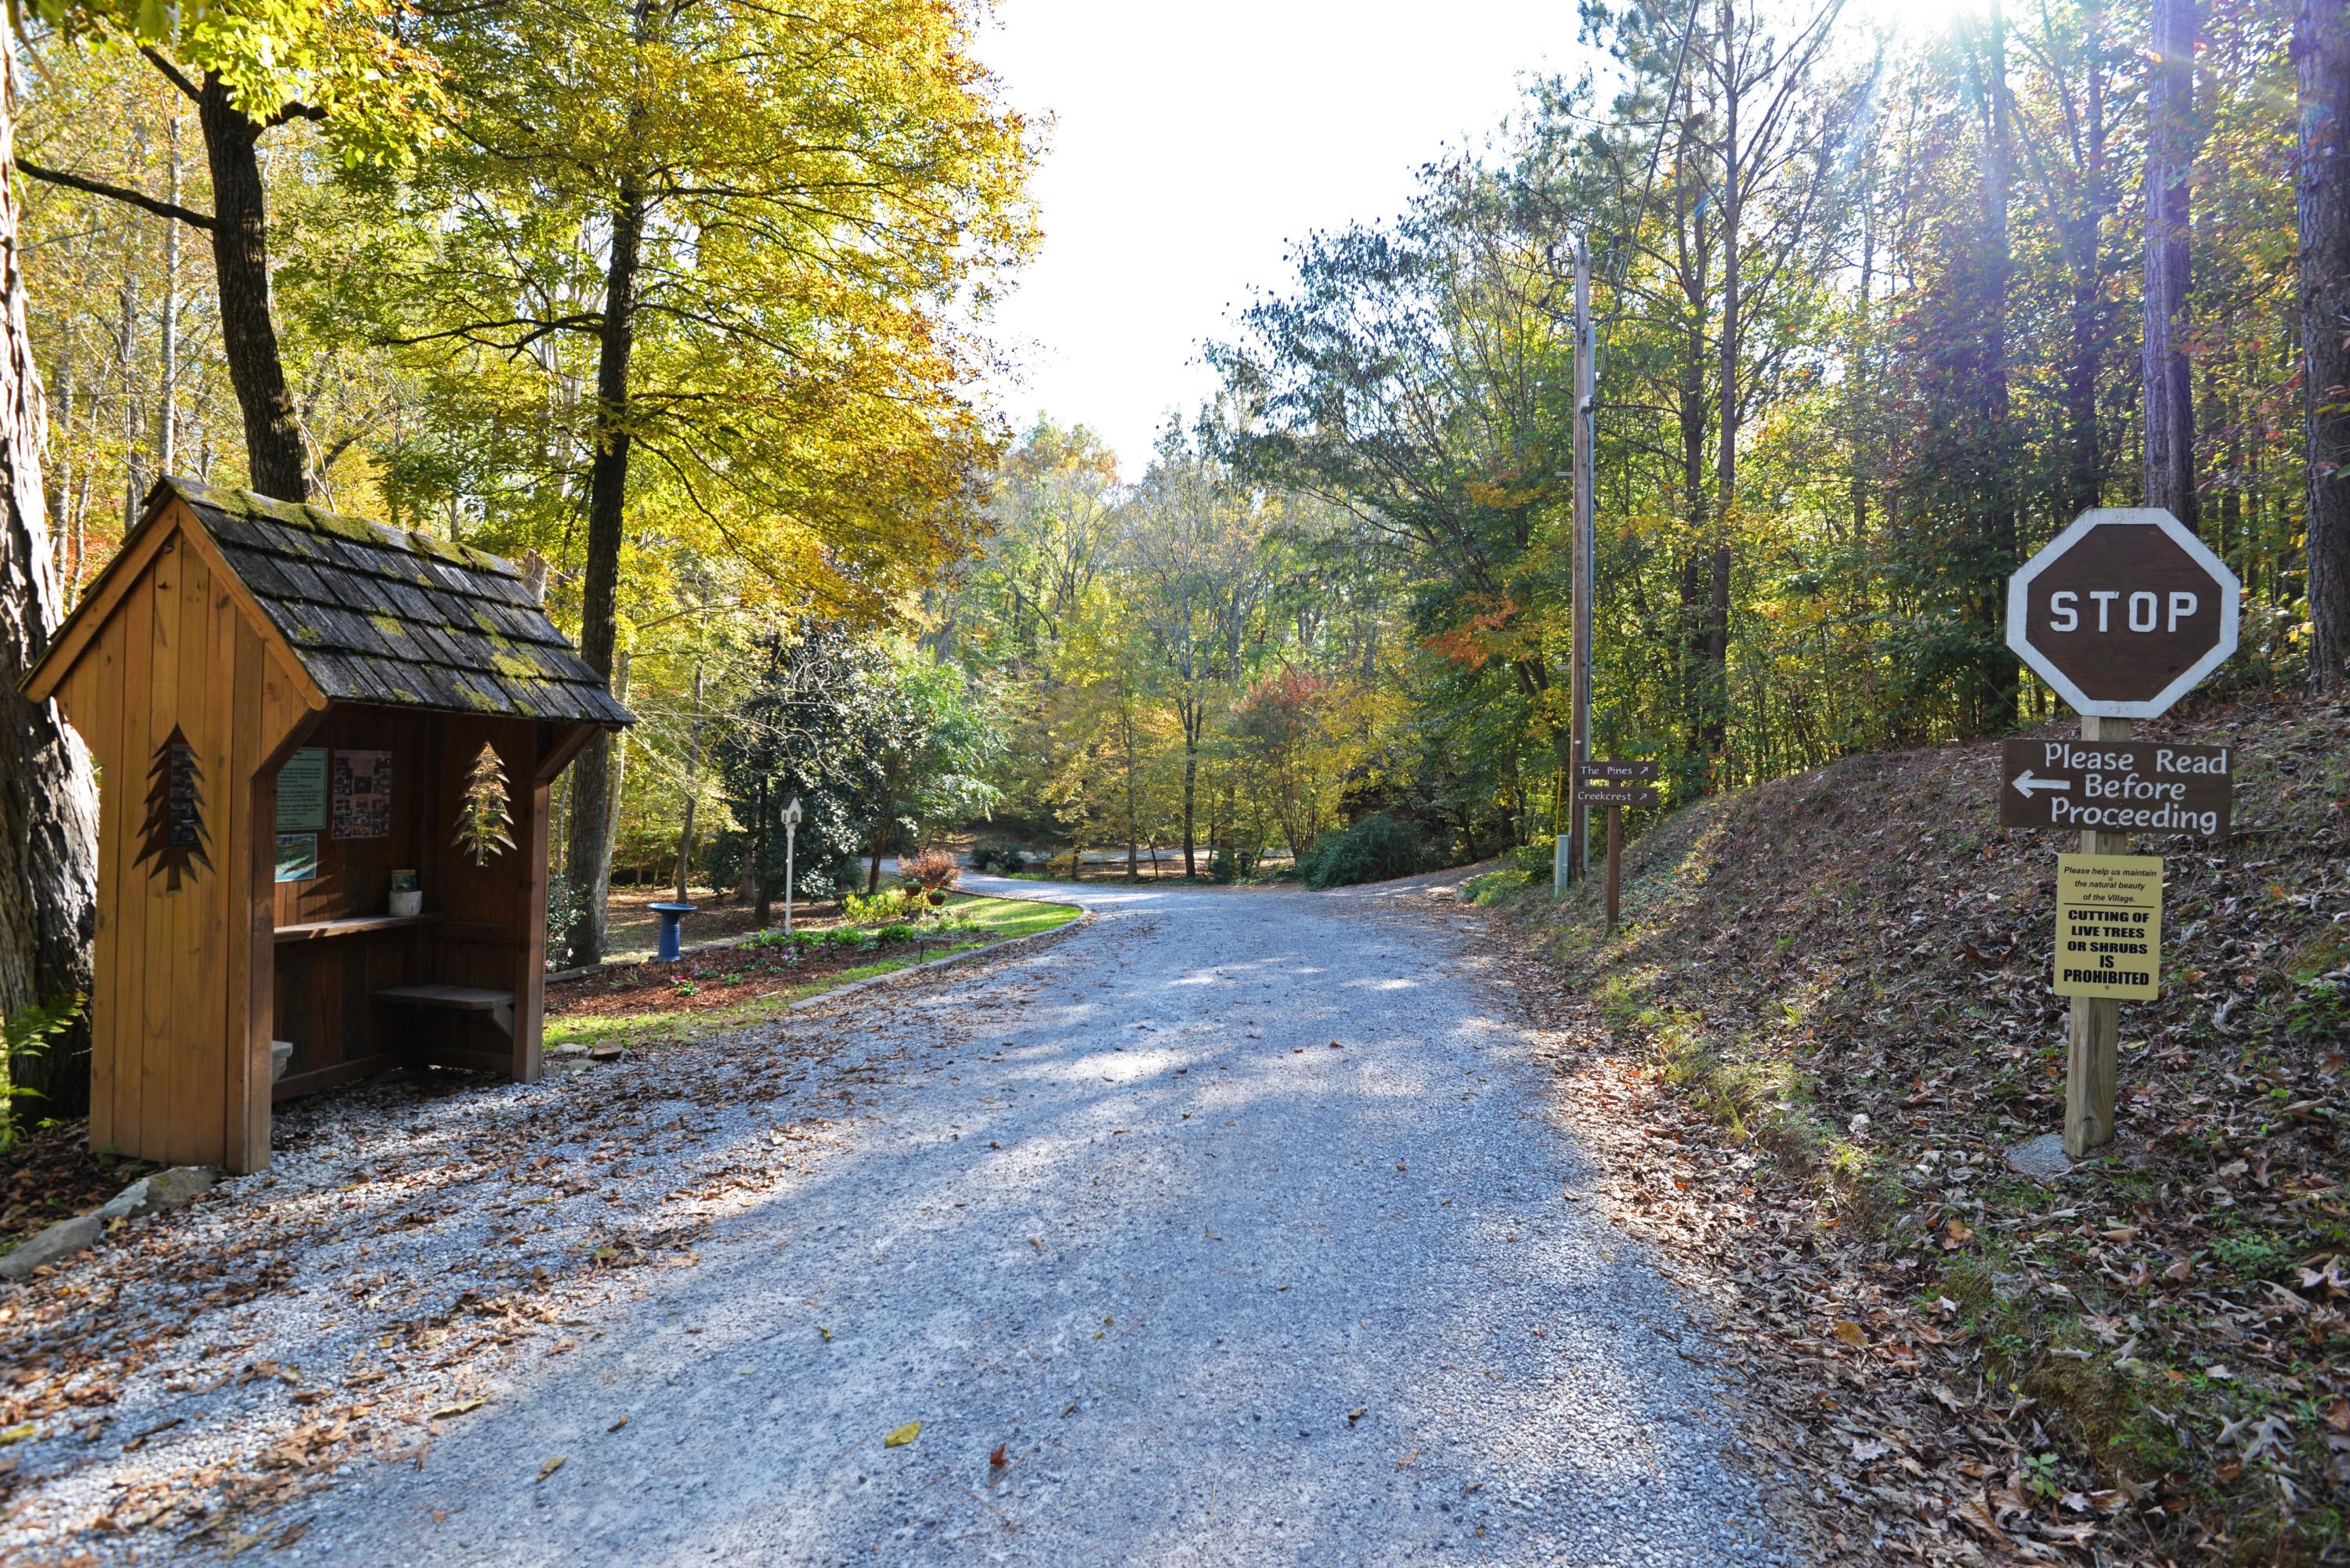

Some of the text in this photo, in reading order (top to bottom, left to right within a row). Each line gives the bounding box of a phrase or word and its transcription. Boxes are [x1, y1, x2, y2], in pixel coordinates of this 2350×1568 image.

[2050, 591, 2197, 633] STOP
[2044, 742, 2227, 775] Please Read
[1580, 765, 1632, 775] The Pines
[2084, 773, 2186, 800] Before
[1578, 791, 1632, 800] Creekcrest
[2051, 796, 2217, 836] Proceeding
[2064, 866, 2090, 875] Please
[2092, 868, 2109, 876] help
[2118, 881, 2145, 891] beauty
[2107, 894, 2136, 903] Village.
[2068, 910, 2149, 923] CUTTING OF
[2071, 926, 2145, 938] LIVE TREES
[2067, 941, 2148, 954] OR SHRUBS
[2099, 955, 2114, 968] IS
[2063, 969, 2149, 985] PROHIBITED
